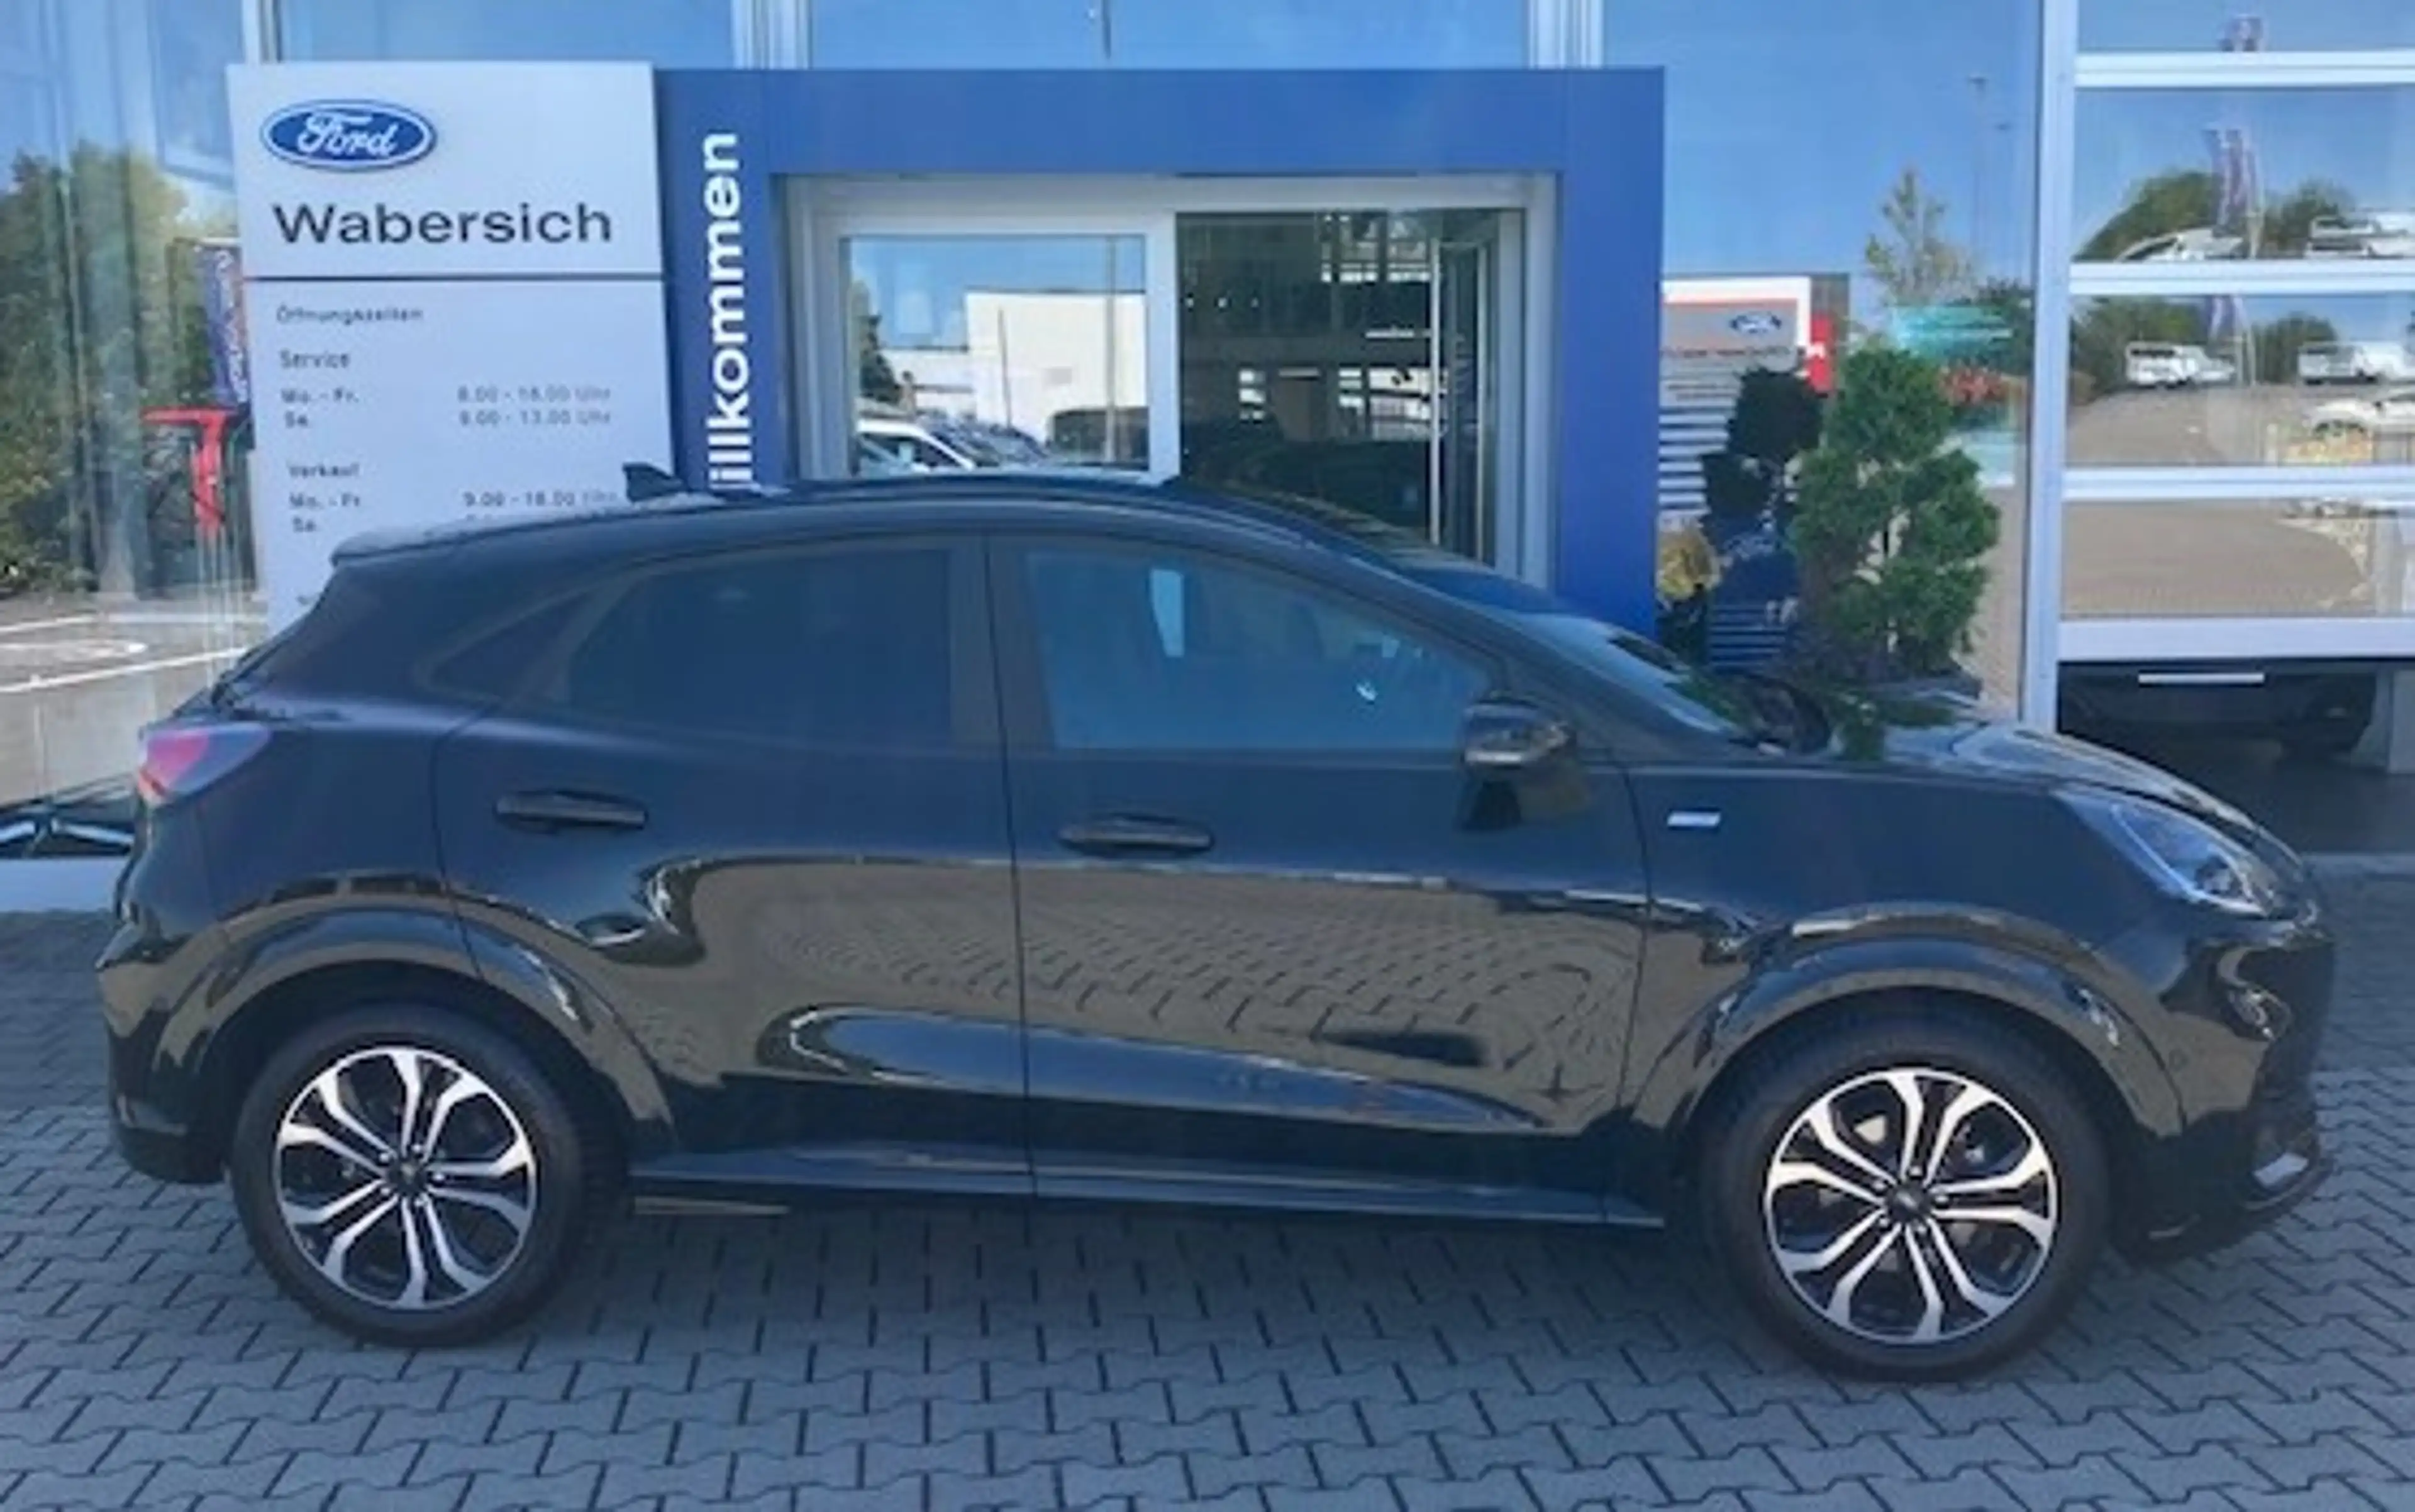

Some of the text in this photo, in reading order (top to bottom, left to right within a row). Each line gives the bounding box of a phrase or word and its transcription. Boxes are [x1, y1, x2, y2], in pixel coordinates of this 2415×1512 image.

[297, 111, 400, 155] Ford
[272, 203, 613, 243] Wabersich
[279, 350, 350, 369] Service
